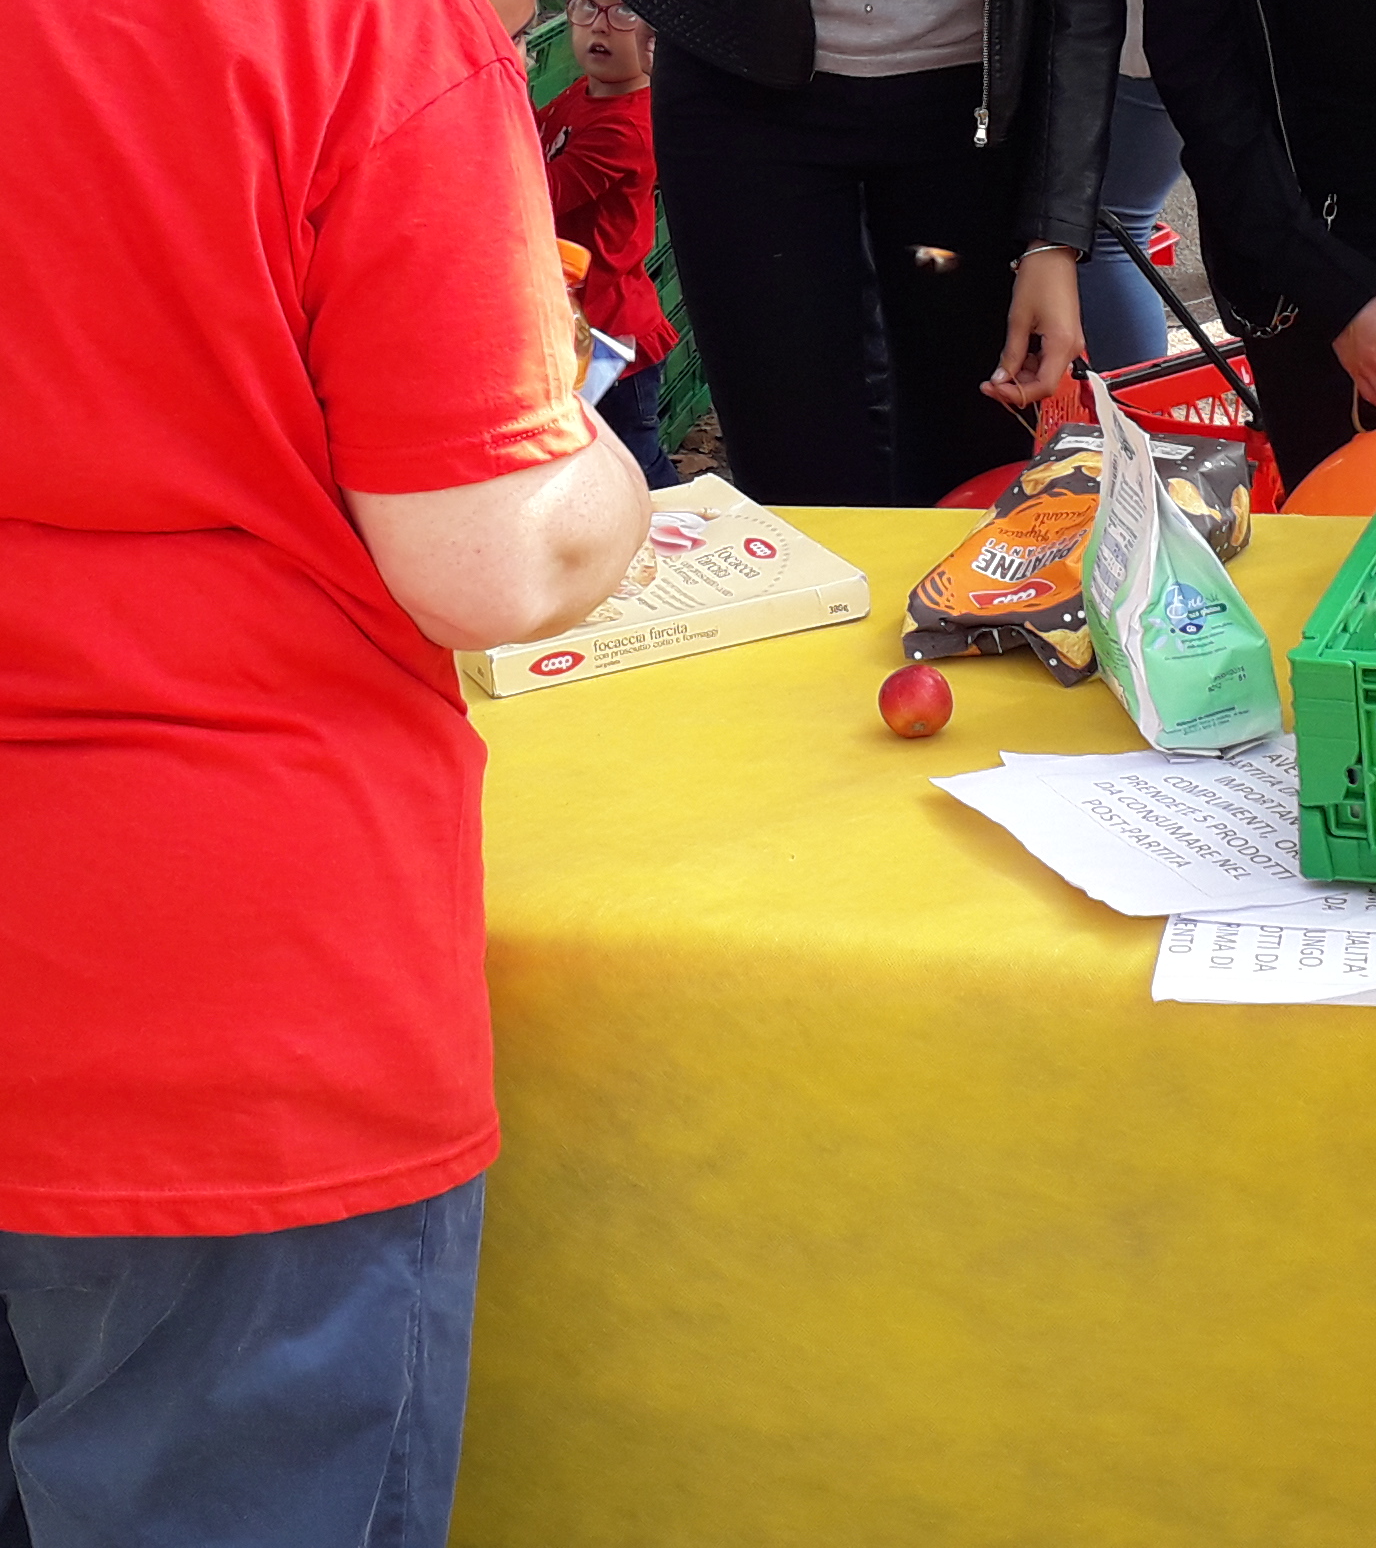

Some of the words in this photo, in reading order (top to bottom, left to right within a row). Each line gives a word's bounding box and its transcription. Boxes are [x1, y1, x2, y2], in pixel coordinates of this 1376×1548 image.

[974, 536, 1082, 582] PATATINE
[592, 629, 646, 654] focaccia
[648, 621, 689, 645] farcita
[540, 654, 573, 672] coop
[1214, 775, 1300, 831] IMPORTAN
[1082, 798, 1192, 869] POST-PARTITA
[1093, 781, 1124, 797] DA
[1118, 796, 1221, 859] CONSUMARE
[1212, 857, 1252, 881] NEL
[1119, 774, 1202, 817] PRENDETE
[1206, 822, 1298, 880] PRODOTTI
[1211, 923, 1241, 953] RIMA
[1255, 925, 1284, 950] OTTI
[1298, 927, 1327, 971] UNGO.
[1208, 955, 1235, 971] DI
[1252, 954, 1279, 974] DA
